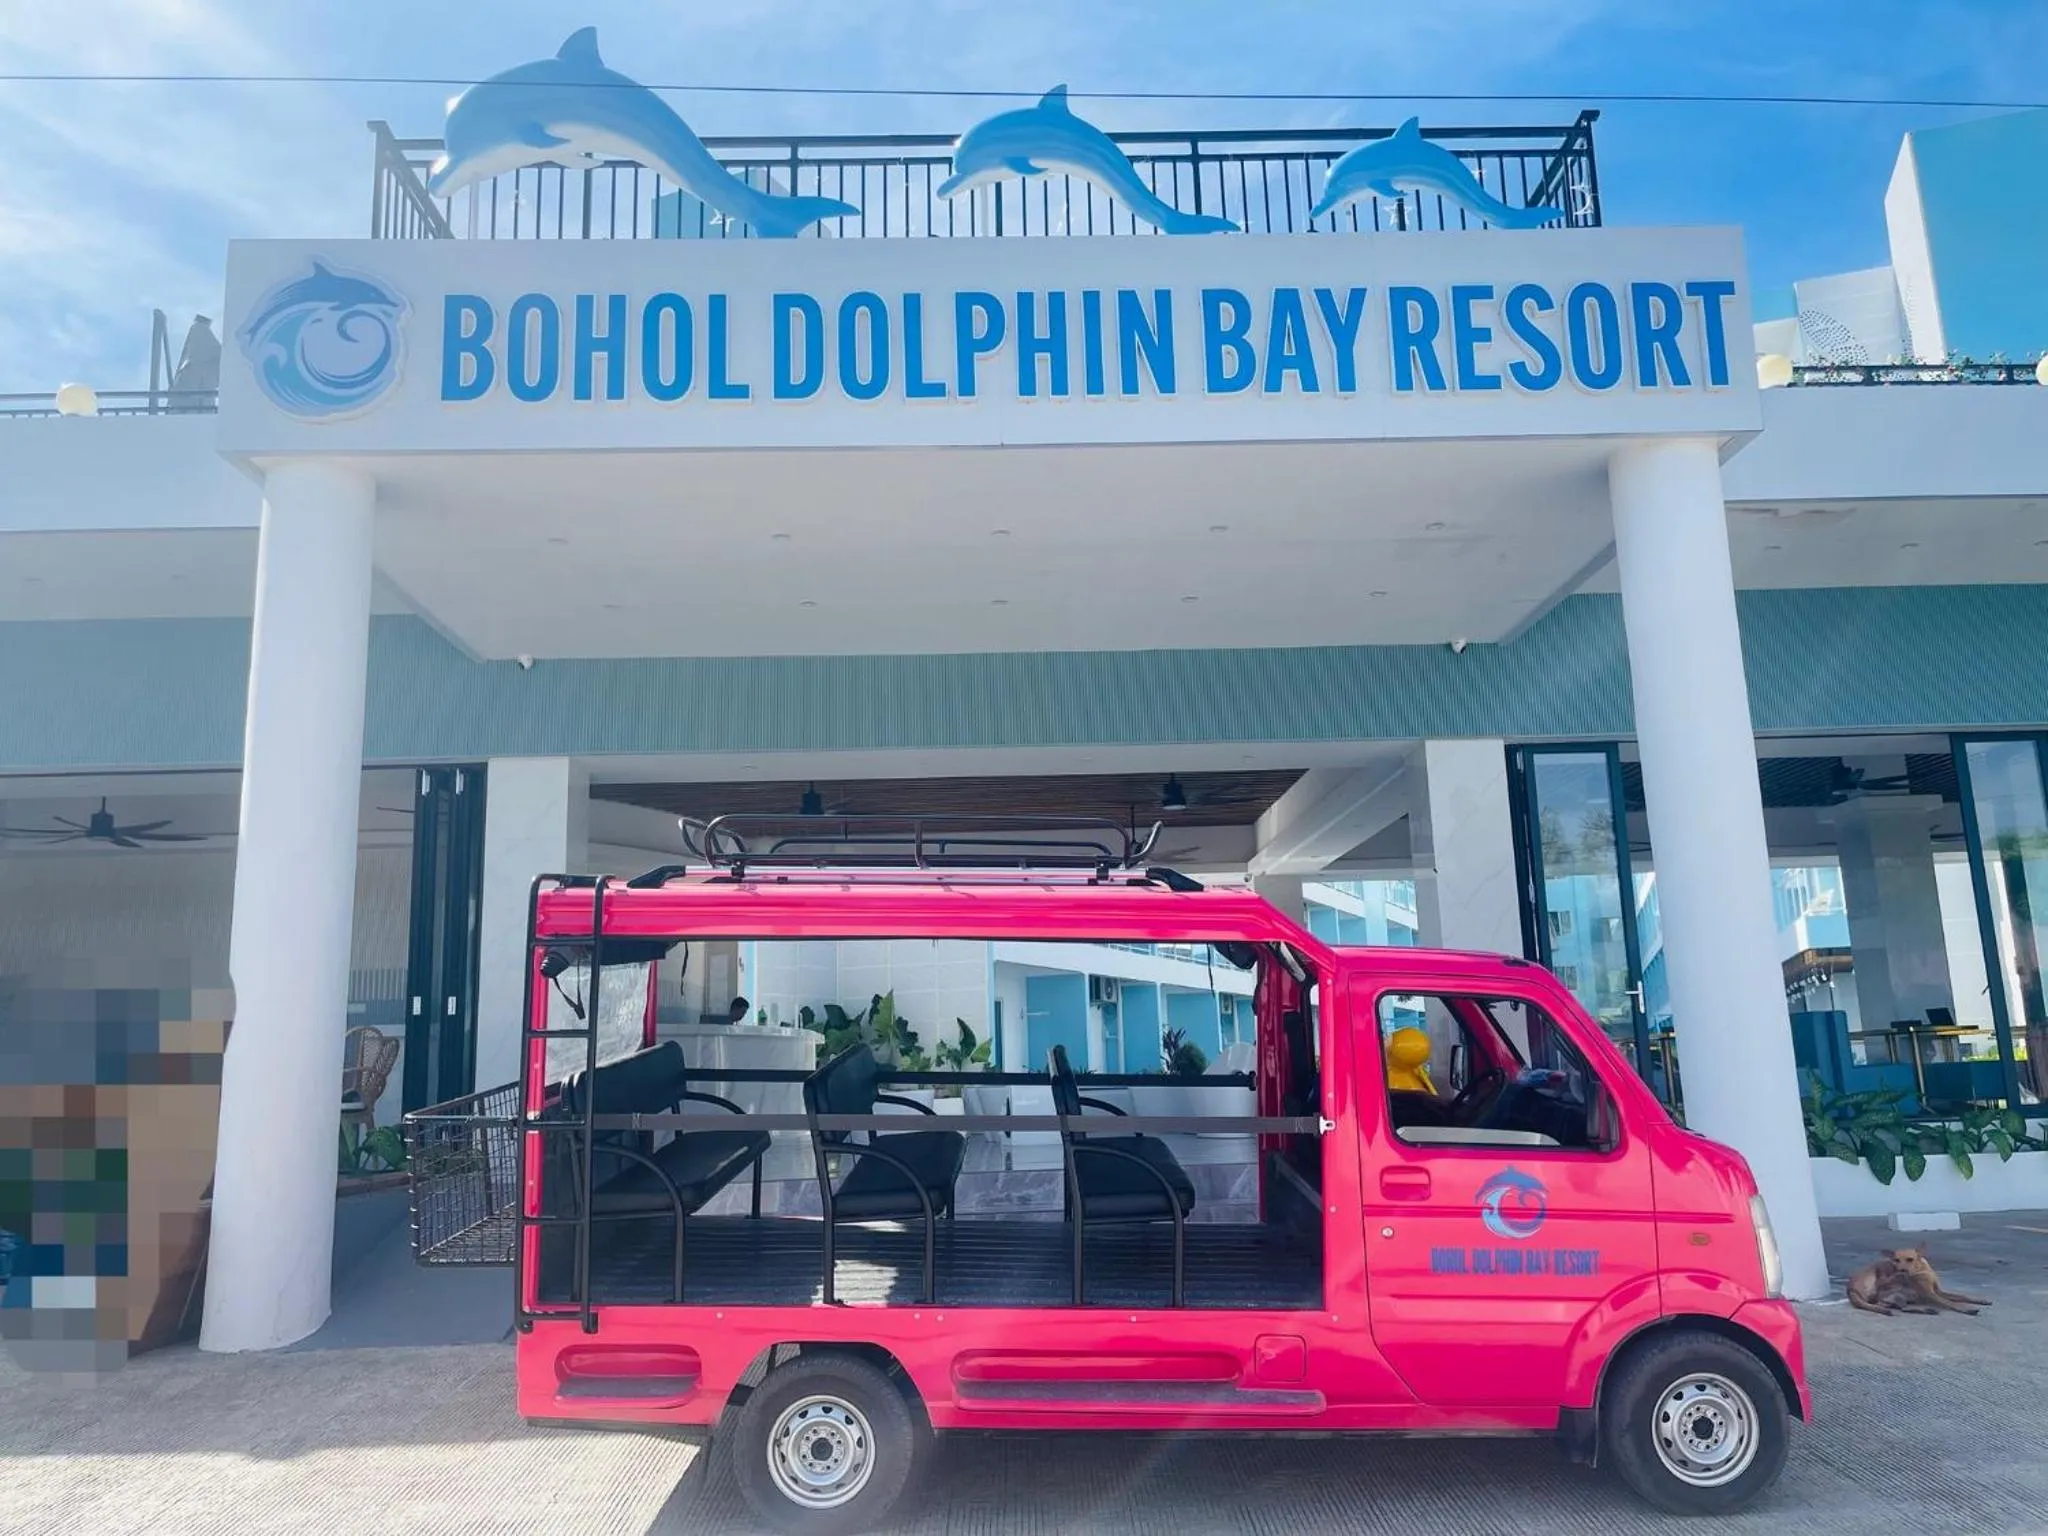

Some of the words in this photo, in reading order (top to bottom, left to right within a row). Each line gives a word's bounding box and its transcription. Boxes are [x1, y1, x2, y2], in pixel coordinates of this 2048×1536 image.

[441, 293, 751, 402] BOHOL
[772, 288, 1177, 401] DOLPHIN
[1202, 287, 1367, 394] BAY
[1389, 280, 1736, 392] RESORT
[1554, 1249, 1600, 1276] RESORT
